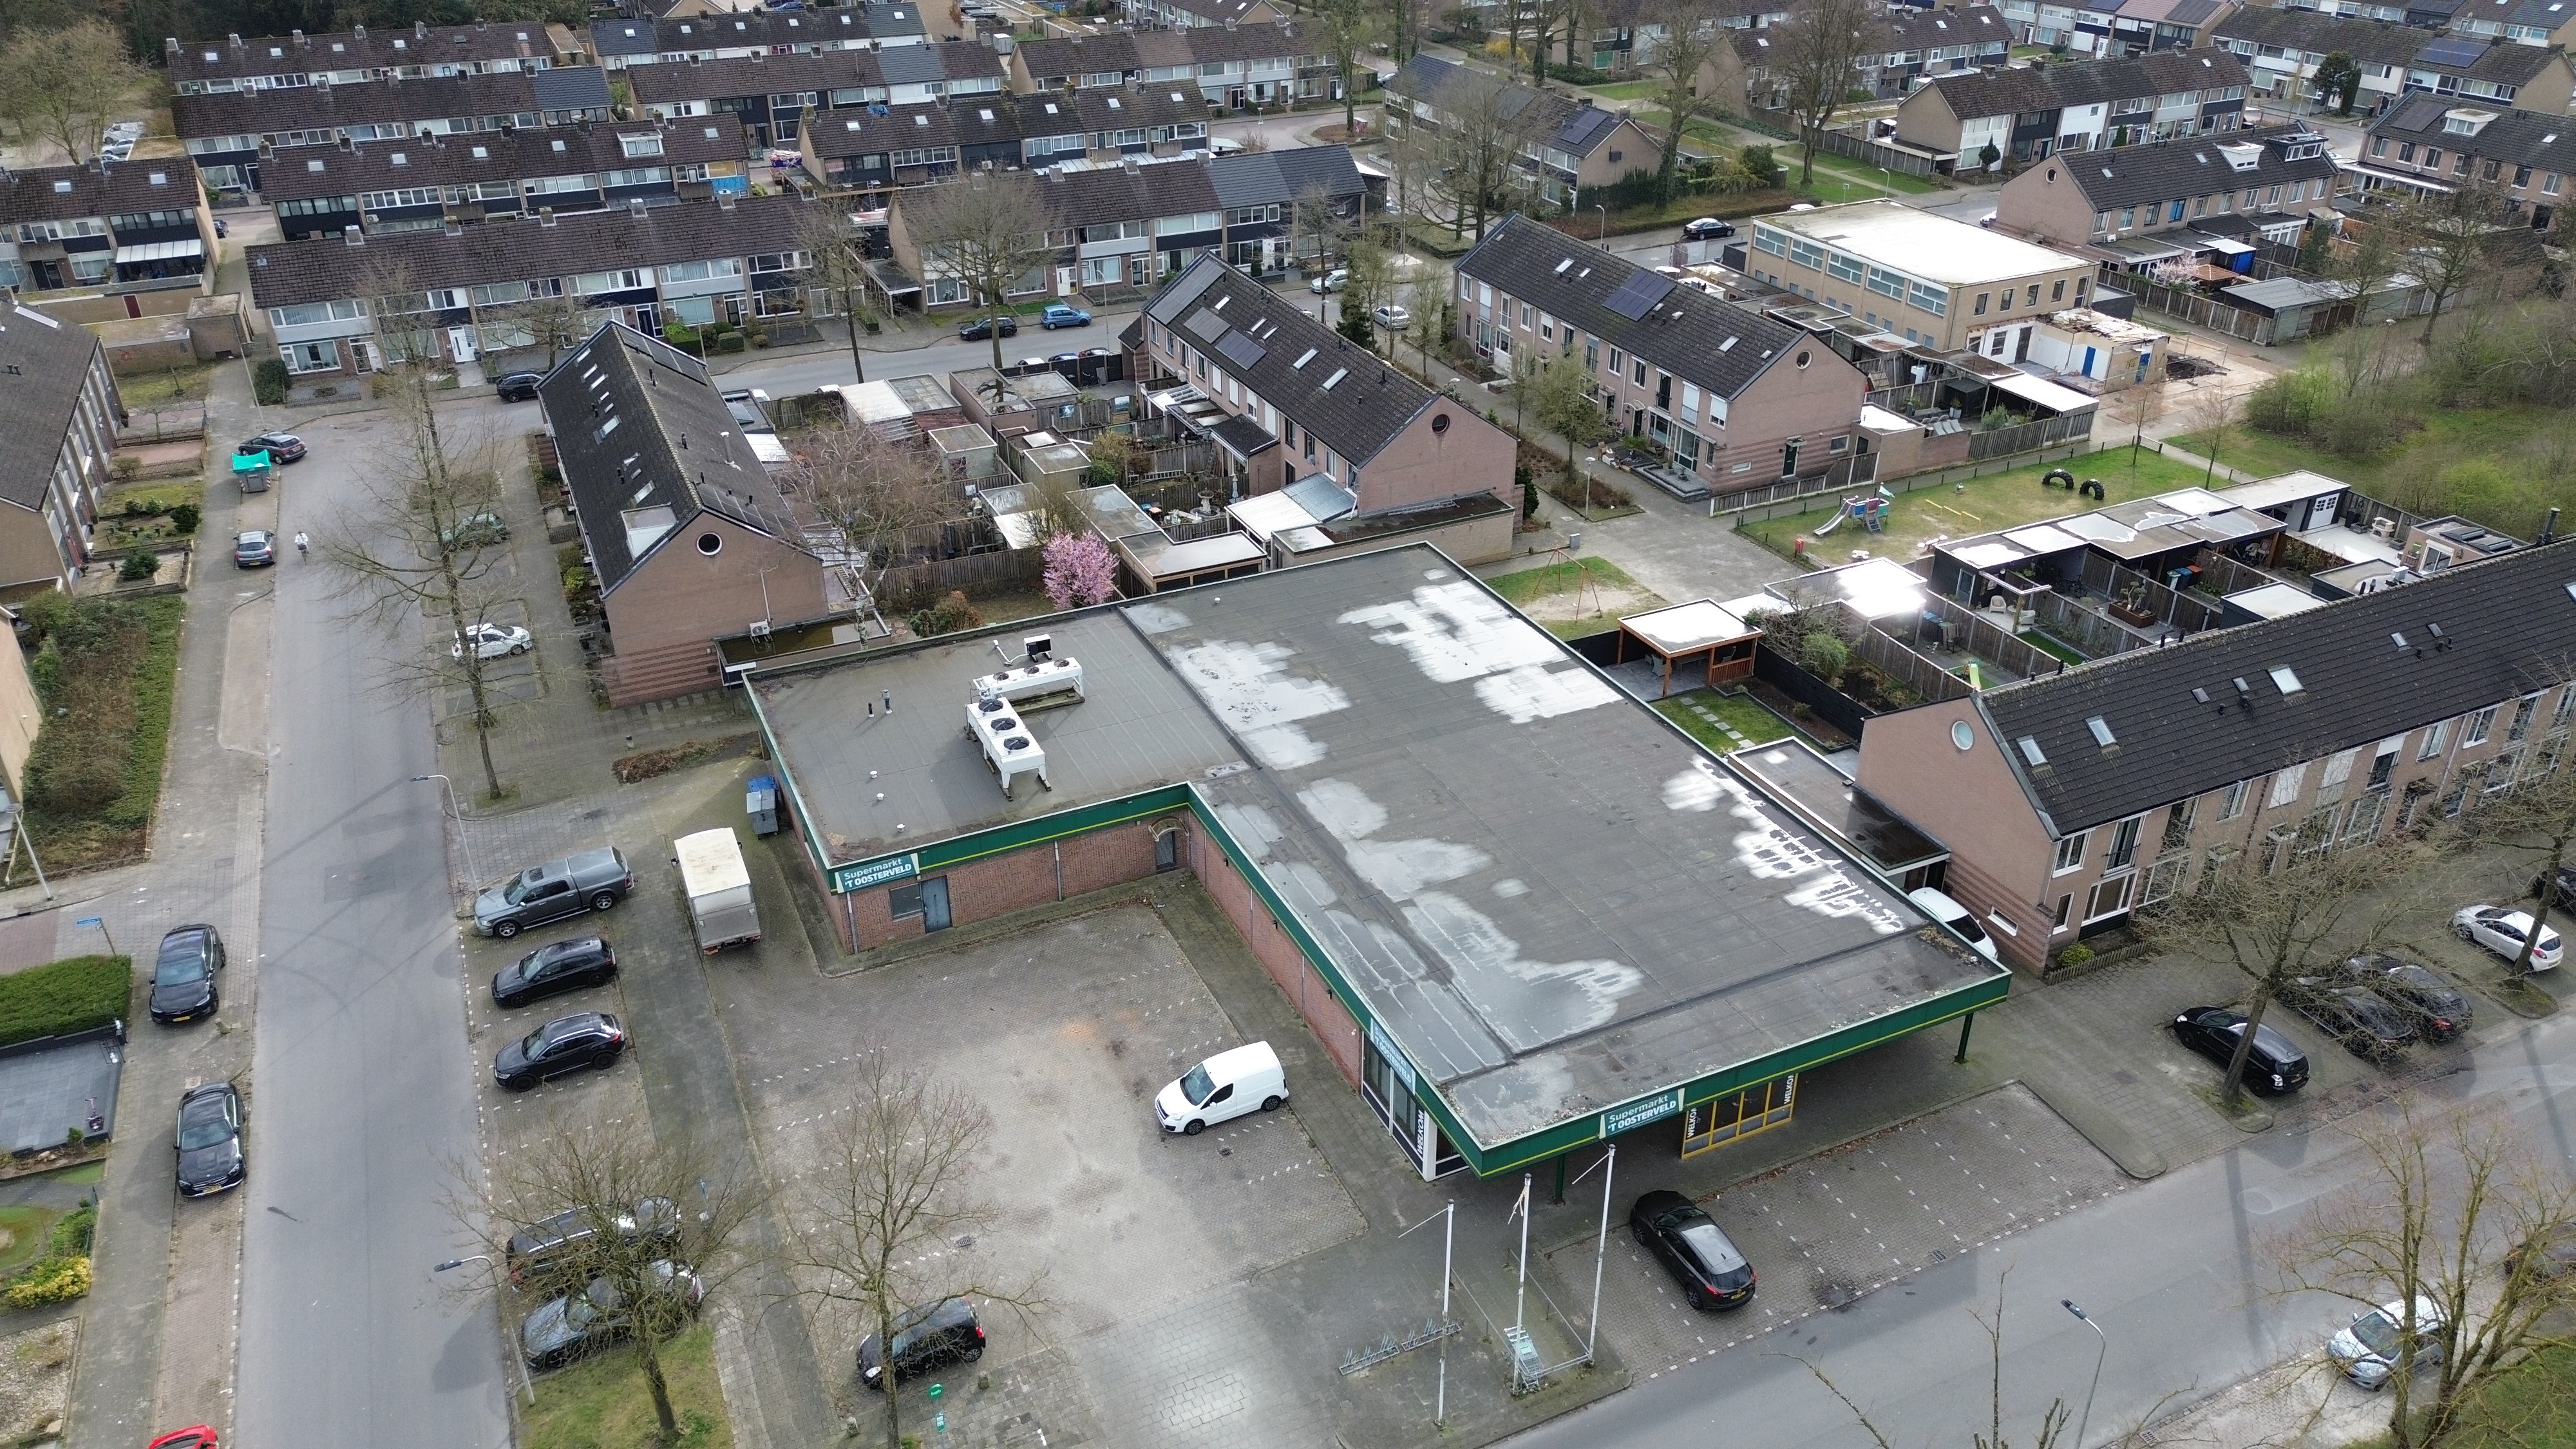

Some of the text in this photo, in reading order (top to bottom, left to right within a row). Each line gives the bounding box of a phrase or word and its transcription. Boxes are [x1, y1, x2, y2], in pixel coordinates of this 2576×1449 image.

[844, 858, 902, 880] Supermarkt
[855, 864, 912, 886] OOSTERVELD
[1375, 1027, 1406, 1068] Supermarkt
[1379, 1043, 1412, 1083] OOSTERVELD
[1609, 1095, 1668, 1123] Supermarkt
[1618, 1100, 1676, 1129] OOSTERVELD
